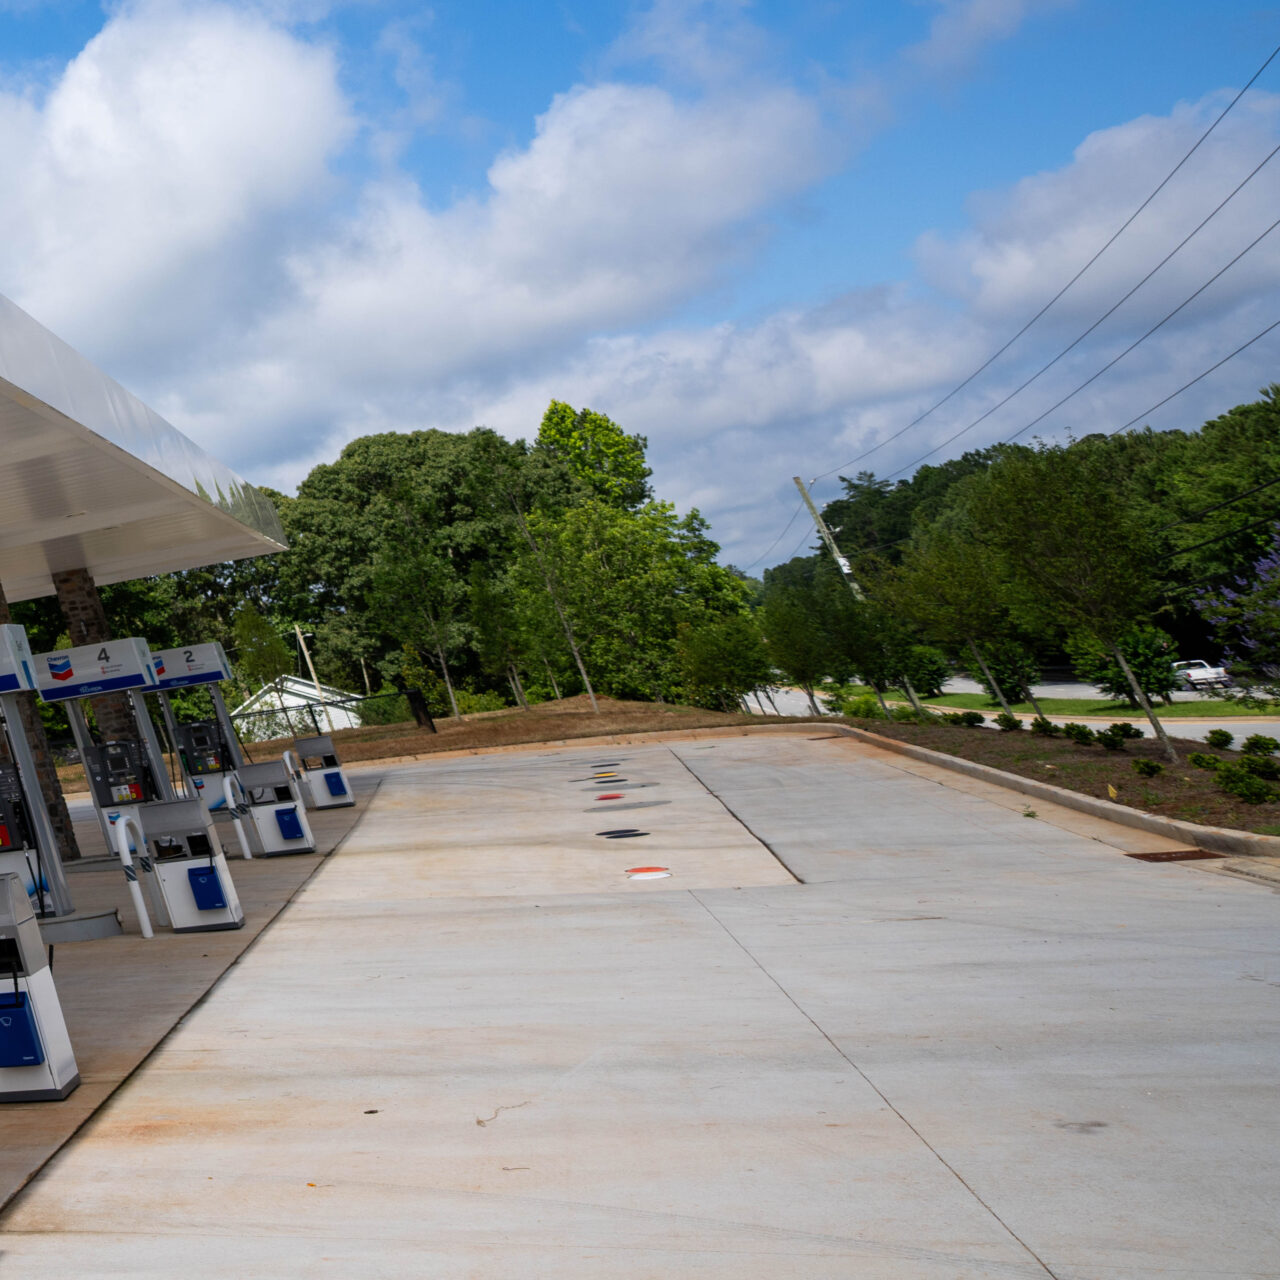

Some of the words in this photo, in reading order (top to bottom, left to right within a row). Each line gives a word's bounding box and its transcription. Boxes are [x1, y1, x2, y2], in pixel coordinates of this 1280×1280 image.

[47, 655, 69, 663] Chevron
[97, 648, 110, 663] 4
[183, 651, 195, 663] 2
